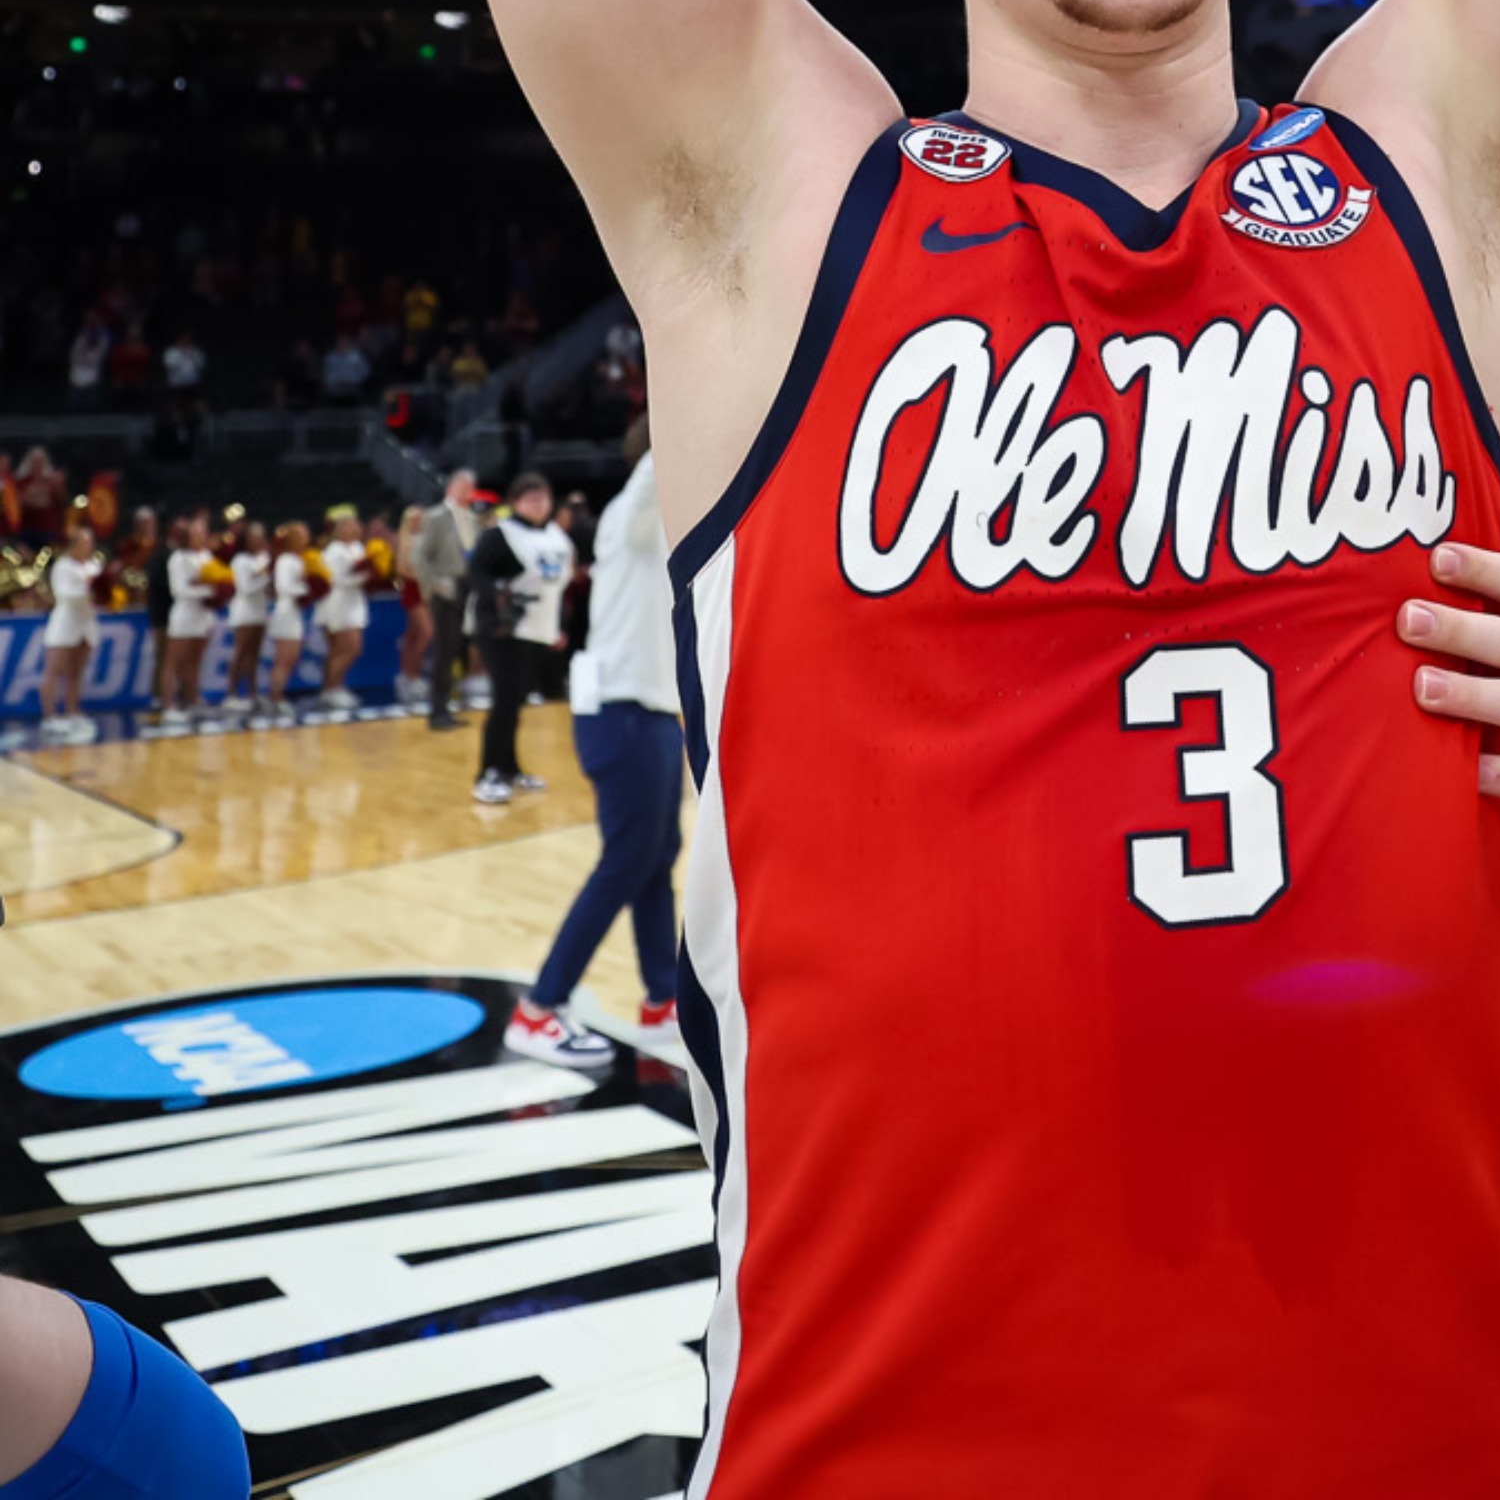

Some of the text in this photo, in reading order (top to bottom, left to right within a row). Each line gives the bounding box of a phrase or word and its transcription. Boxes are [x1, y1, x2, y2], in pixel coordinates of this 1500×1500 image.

[921, 138, 988, 169] 22
[1233, 153, 1336, 225] SEC
[1243, 207, 1363, 247] GRADUATE
[838, 306, 1456, 598] Ole Miss
[1119, 640, 1291, 931] 3
